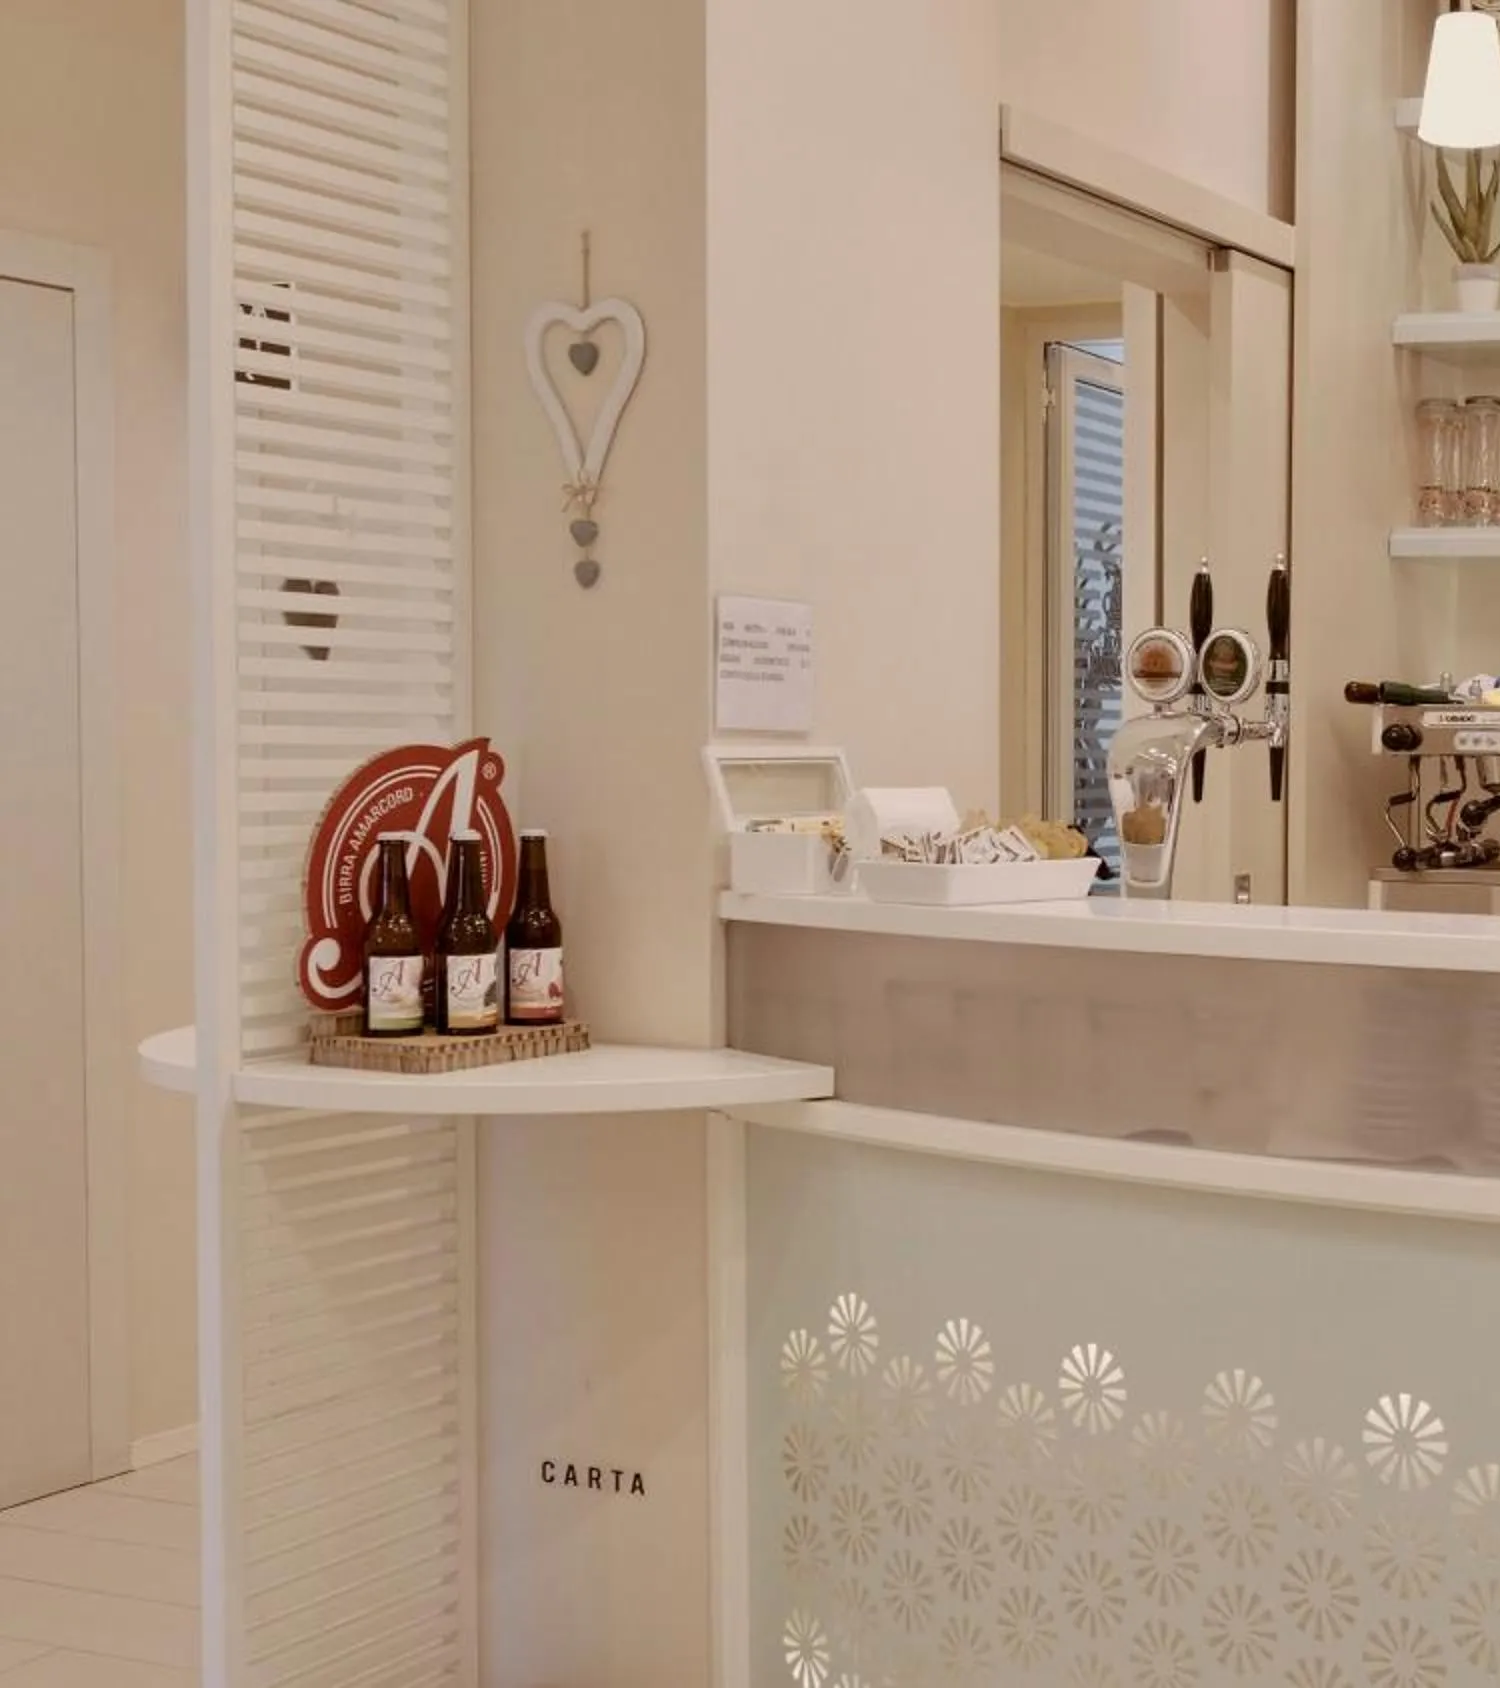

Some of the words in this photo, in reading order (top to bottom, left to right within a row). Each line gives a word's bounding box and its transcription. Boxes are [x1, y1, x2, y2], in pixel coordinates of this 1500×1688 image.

[338, 853, 358, 905] BIRRA
[351, 787, 414, 850] AMARCORD
[541, 1460, 645, 1496] CARTA
